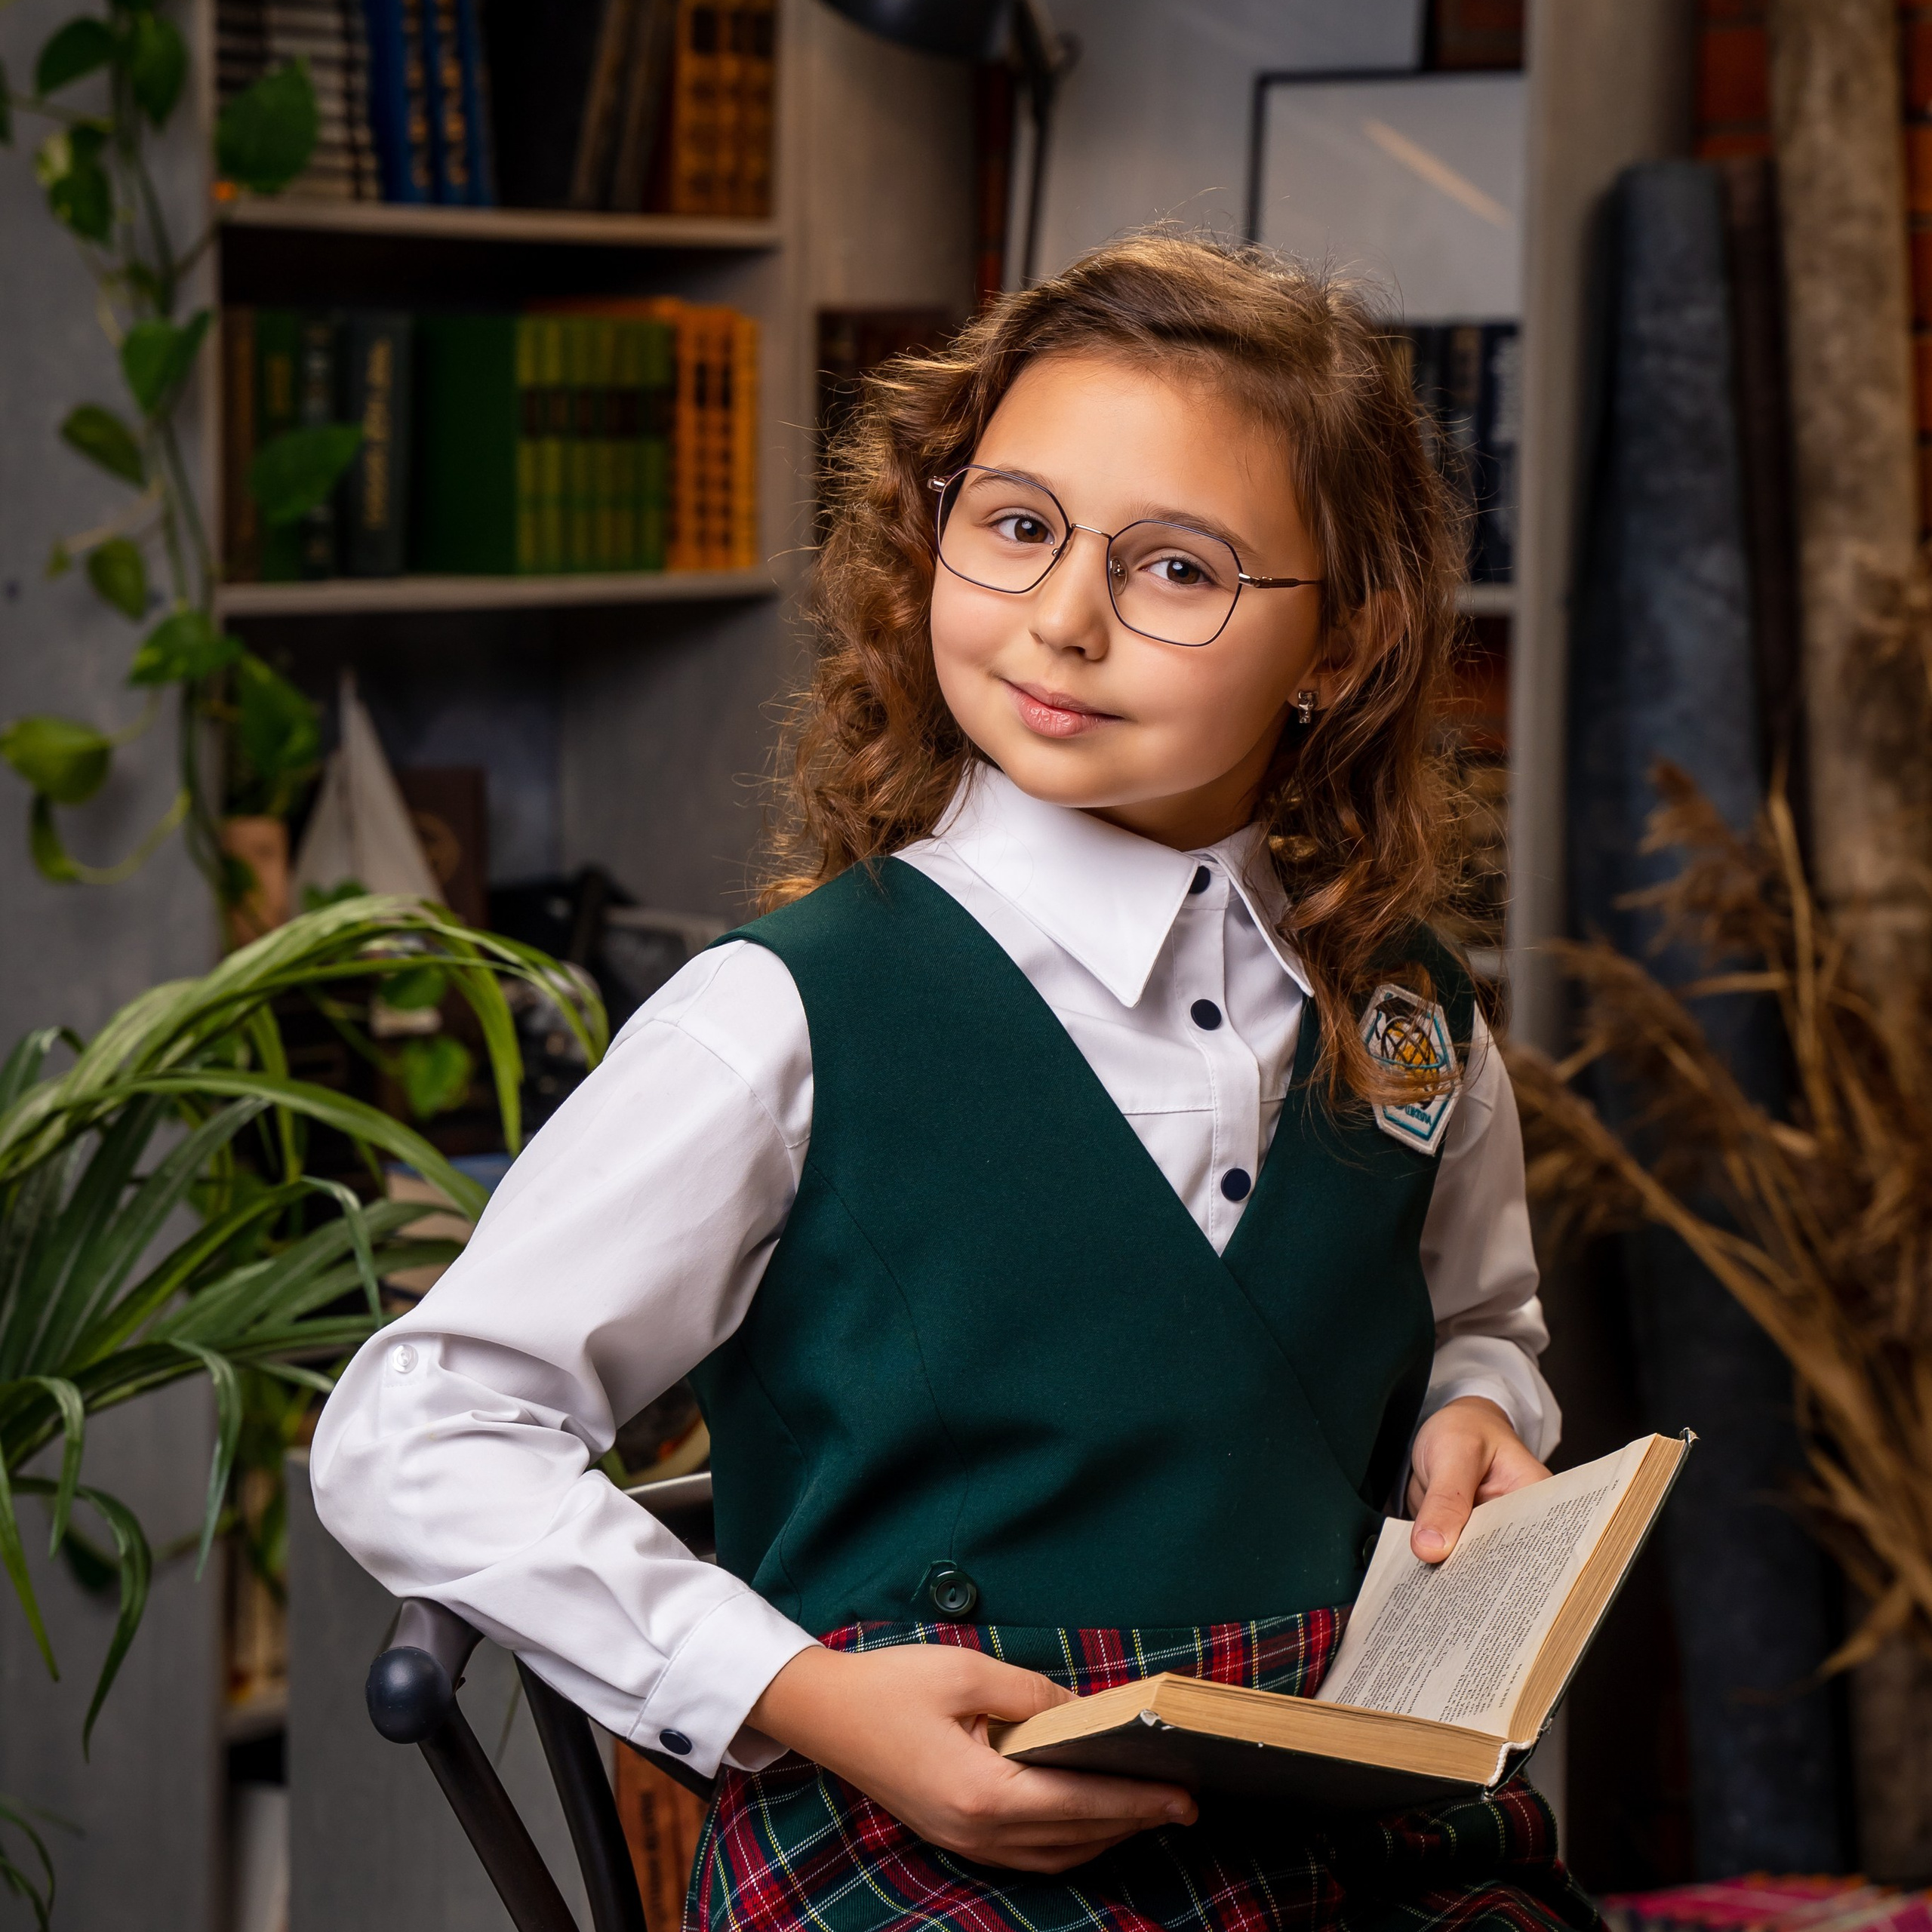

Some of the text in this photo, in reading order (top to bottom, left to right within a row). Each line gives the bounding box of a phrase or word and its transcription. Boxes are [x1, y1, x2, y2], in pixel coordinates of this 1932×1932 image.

[1581, 1506, 1592, 1521] что
[1524, 1521, 1538, 1539] Том
[1540, 1517, 1554, 1535] Оба
[1548, 1523, 1559, 1538] что
[1555, 1527, 1568, 1544] Оба
[1506, 1526, 1525, 1552] Бекки
[1531, 1536, 1543, 1552] они
[1535, 1534, 1549, 1552] Они
[1537, 1539, 1552, 1556] Том
[1499, 1541, 1512, 1558] Это
[1545, 1545, 1557, 1561] они
[1488, 1559, 1501, 1576] наш
[1521, 1561, 1543, 1591] пройти
[1496, 1571, 1513, 1595] очень
[1521, 1570, 1533, 1585] это
[1462, 1577, 1491, 1620] свадебный
[1508, 1582, 1521, 1600] Том
[1525, 1587, 1539, 1604] Том
[1539, 1592, 1550, 1607] они
[1467, 1593, 1490, 1626] спросил
[1476, 1596, 1497, 1628] хочется
[1524, 1595, 1539, 1614] надо
[1510, 1616, 1527, 1640] найти
[1411, 1646, 1424, 1663] Том
[1498, 1638, 1509, 1652] что
[1475, 1647, 1490, 1665] Она
[1483, 1641, 1502, 1670] однако
[1486, 1654, 1500, 1675] пора
[1411, 1660, 1429, 1685] чтобы
[1494, 1671, 1508, 1690] Том
[1447, 1674, 1465, 1703] Потом
[1454, 1674, 1469, 1697] свечу
[1469, 1672, 1486, 1699] Бекки
[1473, 1676, 1488, 1701] опять
[1497, 1663, 1523, 1708] МАРК ТВЕН
[1447, 1680, 1471, 1721] понимала
[1471, 1686, 1490, 1715] Скоро
